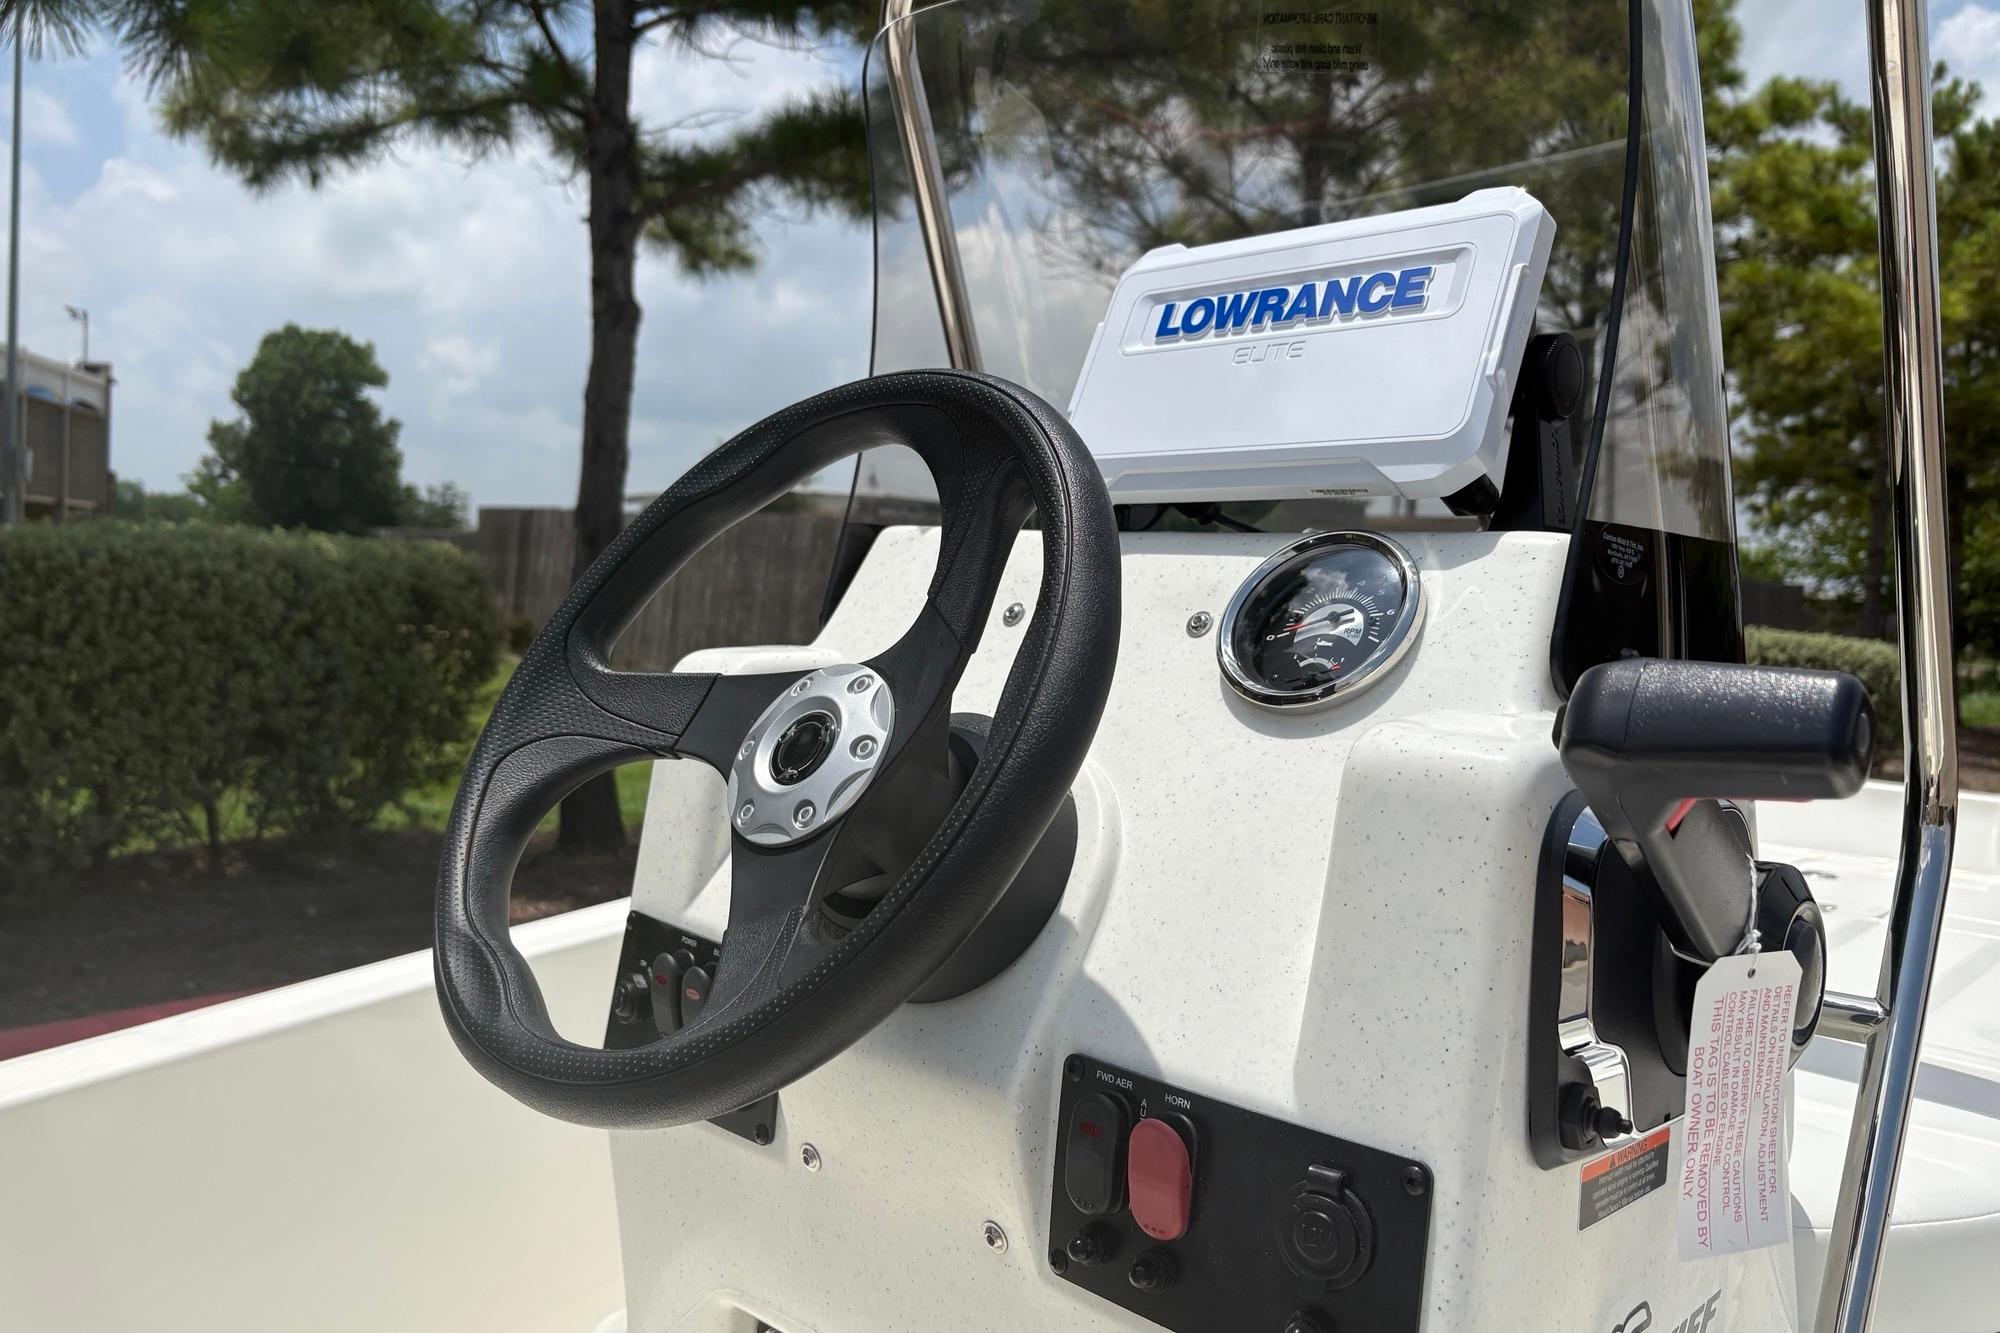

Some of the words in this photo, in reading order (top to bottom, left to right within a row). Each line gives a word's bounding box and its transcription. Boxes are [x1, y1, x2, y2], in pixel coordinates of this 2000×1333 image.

[1155, 266, 1432, 341] LOWRANCE
[1232, 340, 1306, 364] ELITE
[1343, 627, 1362, 635] RPM
[1711, 996, 1724, 1032] THIS
[1738, 990, 1747, 1014] MAY
[1745, 990, 1758, 1038] FAILURE
[1763, 988, 1772, 1011] AND
[1770, 986, 1782, 1034] DETAILS
[1781, 985, 1792, 1024] REFER
[1724, 992, 1737, 1050] CONTROL
[1779, 1027, 1787, 1042] TO
[1708, 1036, 1720, 1068] TAG
[1733, 1017, 1744, 1062] RESULT
[1744, 1041, 1752, 1056] TO
[1768, 1037, 1777, 1053] ON
[1096, 1070, 1115, 1084] FWD
[1115, 1079, 1133, 1090] AER
[1692, 1047, 1705, 1088] BOAT
[1707, 1072, 1717, 1088] IS
[1721, 1052, 1731, 1099] CABLES
[1732, 1067, 1740, 1078] IN
[1771, 1045, 1785, 1123] INSTRUCTION
[1164, 1093, 1191, 1110] HORN
[1706, 1091, 1716, 1113] TO
[1740, 1060, 1750, 1116] OBSERVE
[1688, 1093, 1702, 1153] OWNER
[1720, 1102, 1728, 1120] OR
[1727, 1081, 1739, 1132] DAMAGE
[1704, 1118, 1716, 1139] BE
[1725, 1133, 1733, 1150] TO
[1734, 1119, 1745, 1157] THESE
[1769, 1127, 1777, 1164] SHEET
[1697, 1143, 1711, 1222] REMOVED
[1733, 1160, 1742, 1223] CAUTIONS
[1757, 1143, 1769, 1222] ADJUSTMENT
[1769, 1168, 1777, 1194] FOR
[1698, 1227, 1709, 1248] BY
